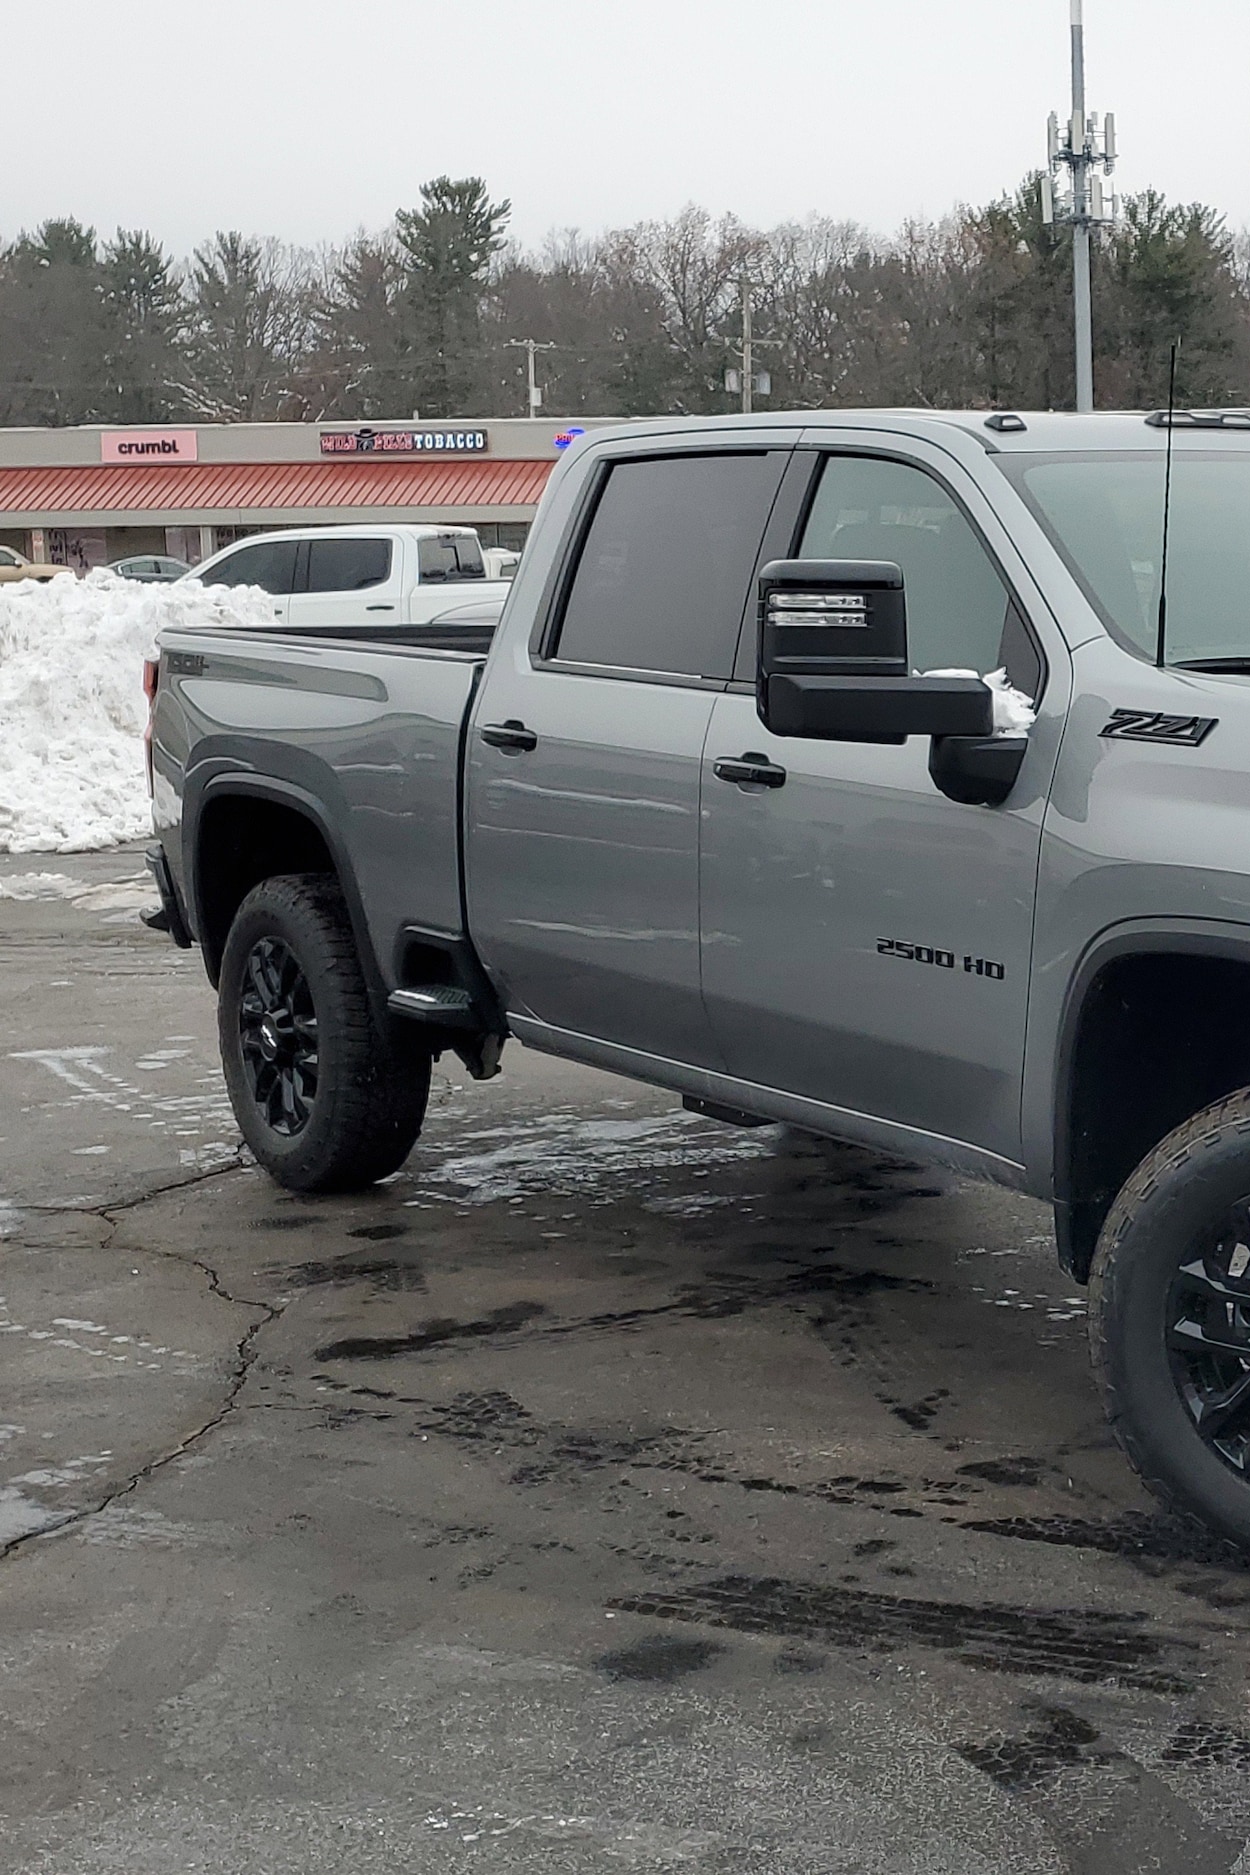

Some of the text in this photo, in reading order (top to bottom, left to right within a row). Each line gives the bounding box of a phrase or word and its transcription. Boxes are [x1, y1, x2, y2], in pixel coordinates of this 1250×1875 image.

[117, 439, 180, 455] crumbl
[414, 432, 485, 450] TOBACCO
[1097, 707, 1220, 748] Z71
[876, 936, 1005, 981] 2500 HD
